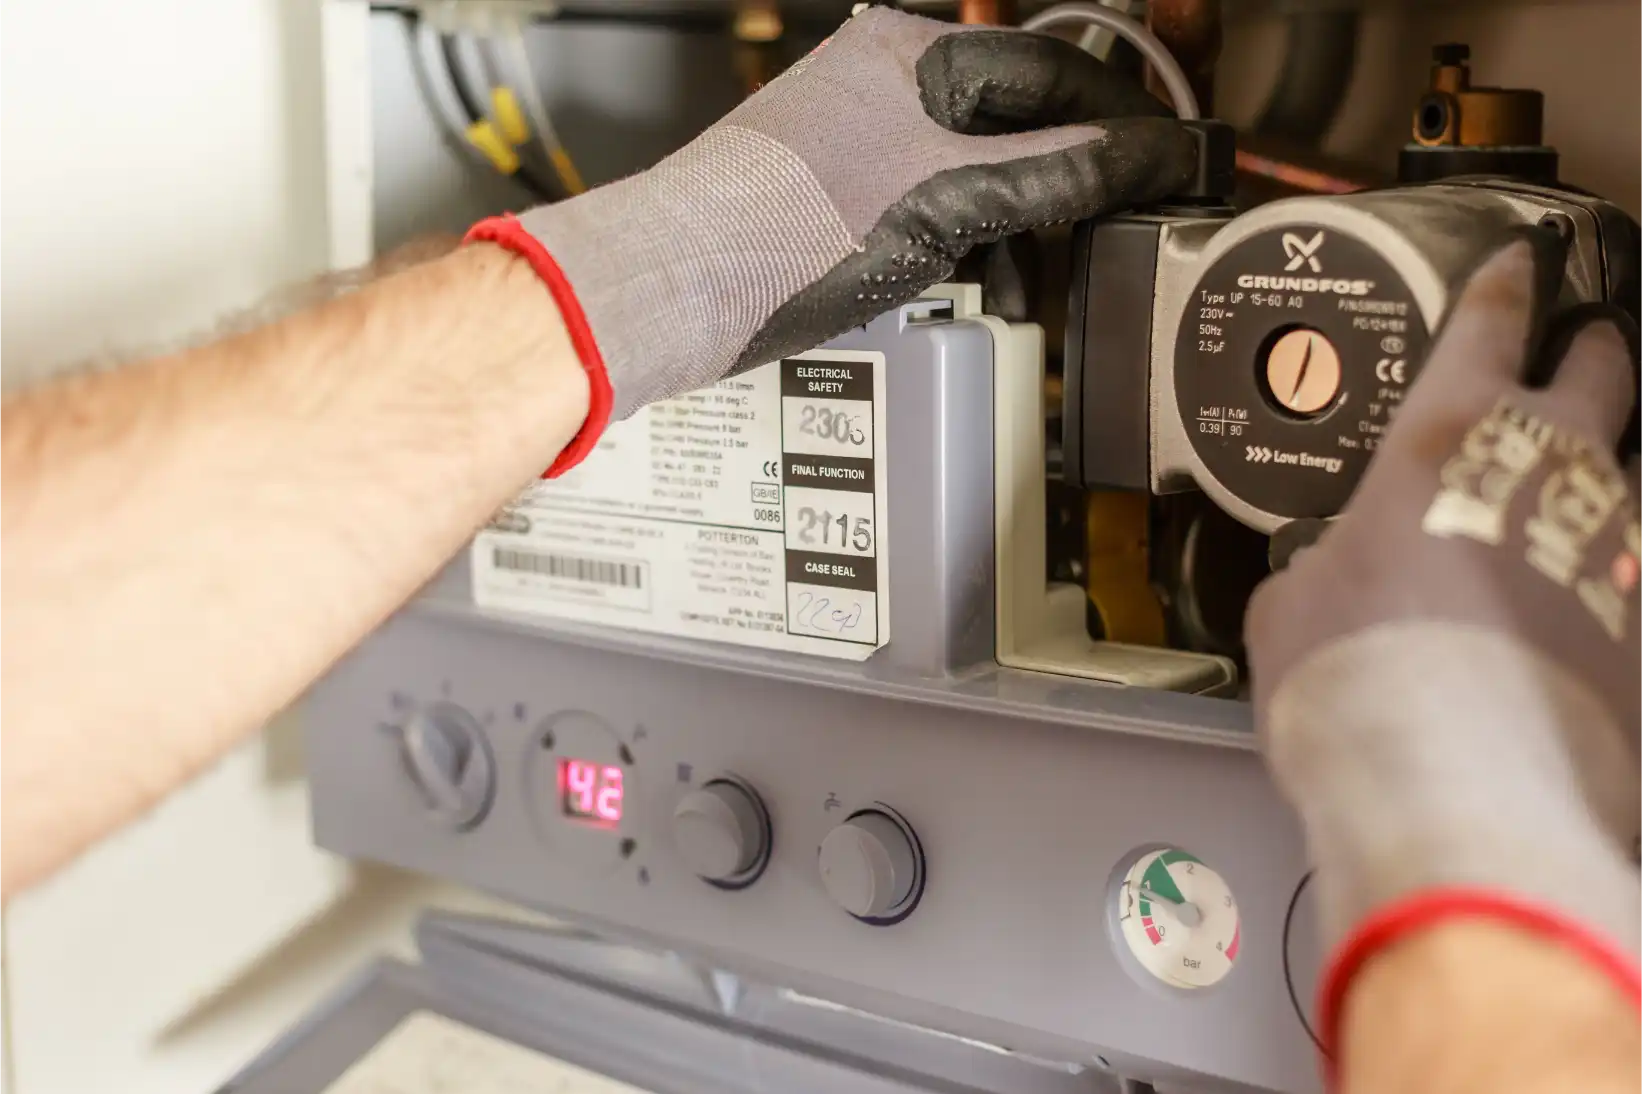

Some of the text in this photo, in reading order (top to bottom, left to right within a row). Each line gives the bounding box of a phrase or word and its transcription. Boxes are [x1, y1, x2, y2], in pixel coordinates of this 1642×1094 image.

[1237, 274, 1369, 296] GRUNDFOS
[1200, 289, 1225, 305] Type
[1230, 291, 1244, 304] UP
[1250, 293, 1283, 307] 15-60
[1199, 323, 1223, 336] 50Hz
[797, 367, 853, 379] ELECTRICAL
[808, 381, 843, 393] SAFETY
[1199, 422, 1220, 434] 0.39
[1230, 425, 1242, 436] 90
[1273, 450, 1343, 474] Low Energy
[791, 464, 865, 479] FINAL FUNCTION
[754, 508, 780, 523] 0086
[797, 506, 872, 552] 2115
[804, 562, 856, 577] CASE SEAL
[567, 760, 623, 821] 42
[1186, 863, 1194, 875] 2
[1224, 895, 1232, 908] 3
[1158, 925, 1166, 937] 0
[1216, 941, 1223, 951] 4
[1183, 956, 1202, 969] bar
